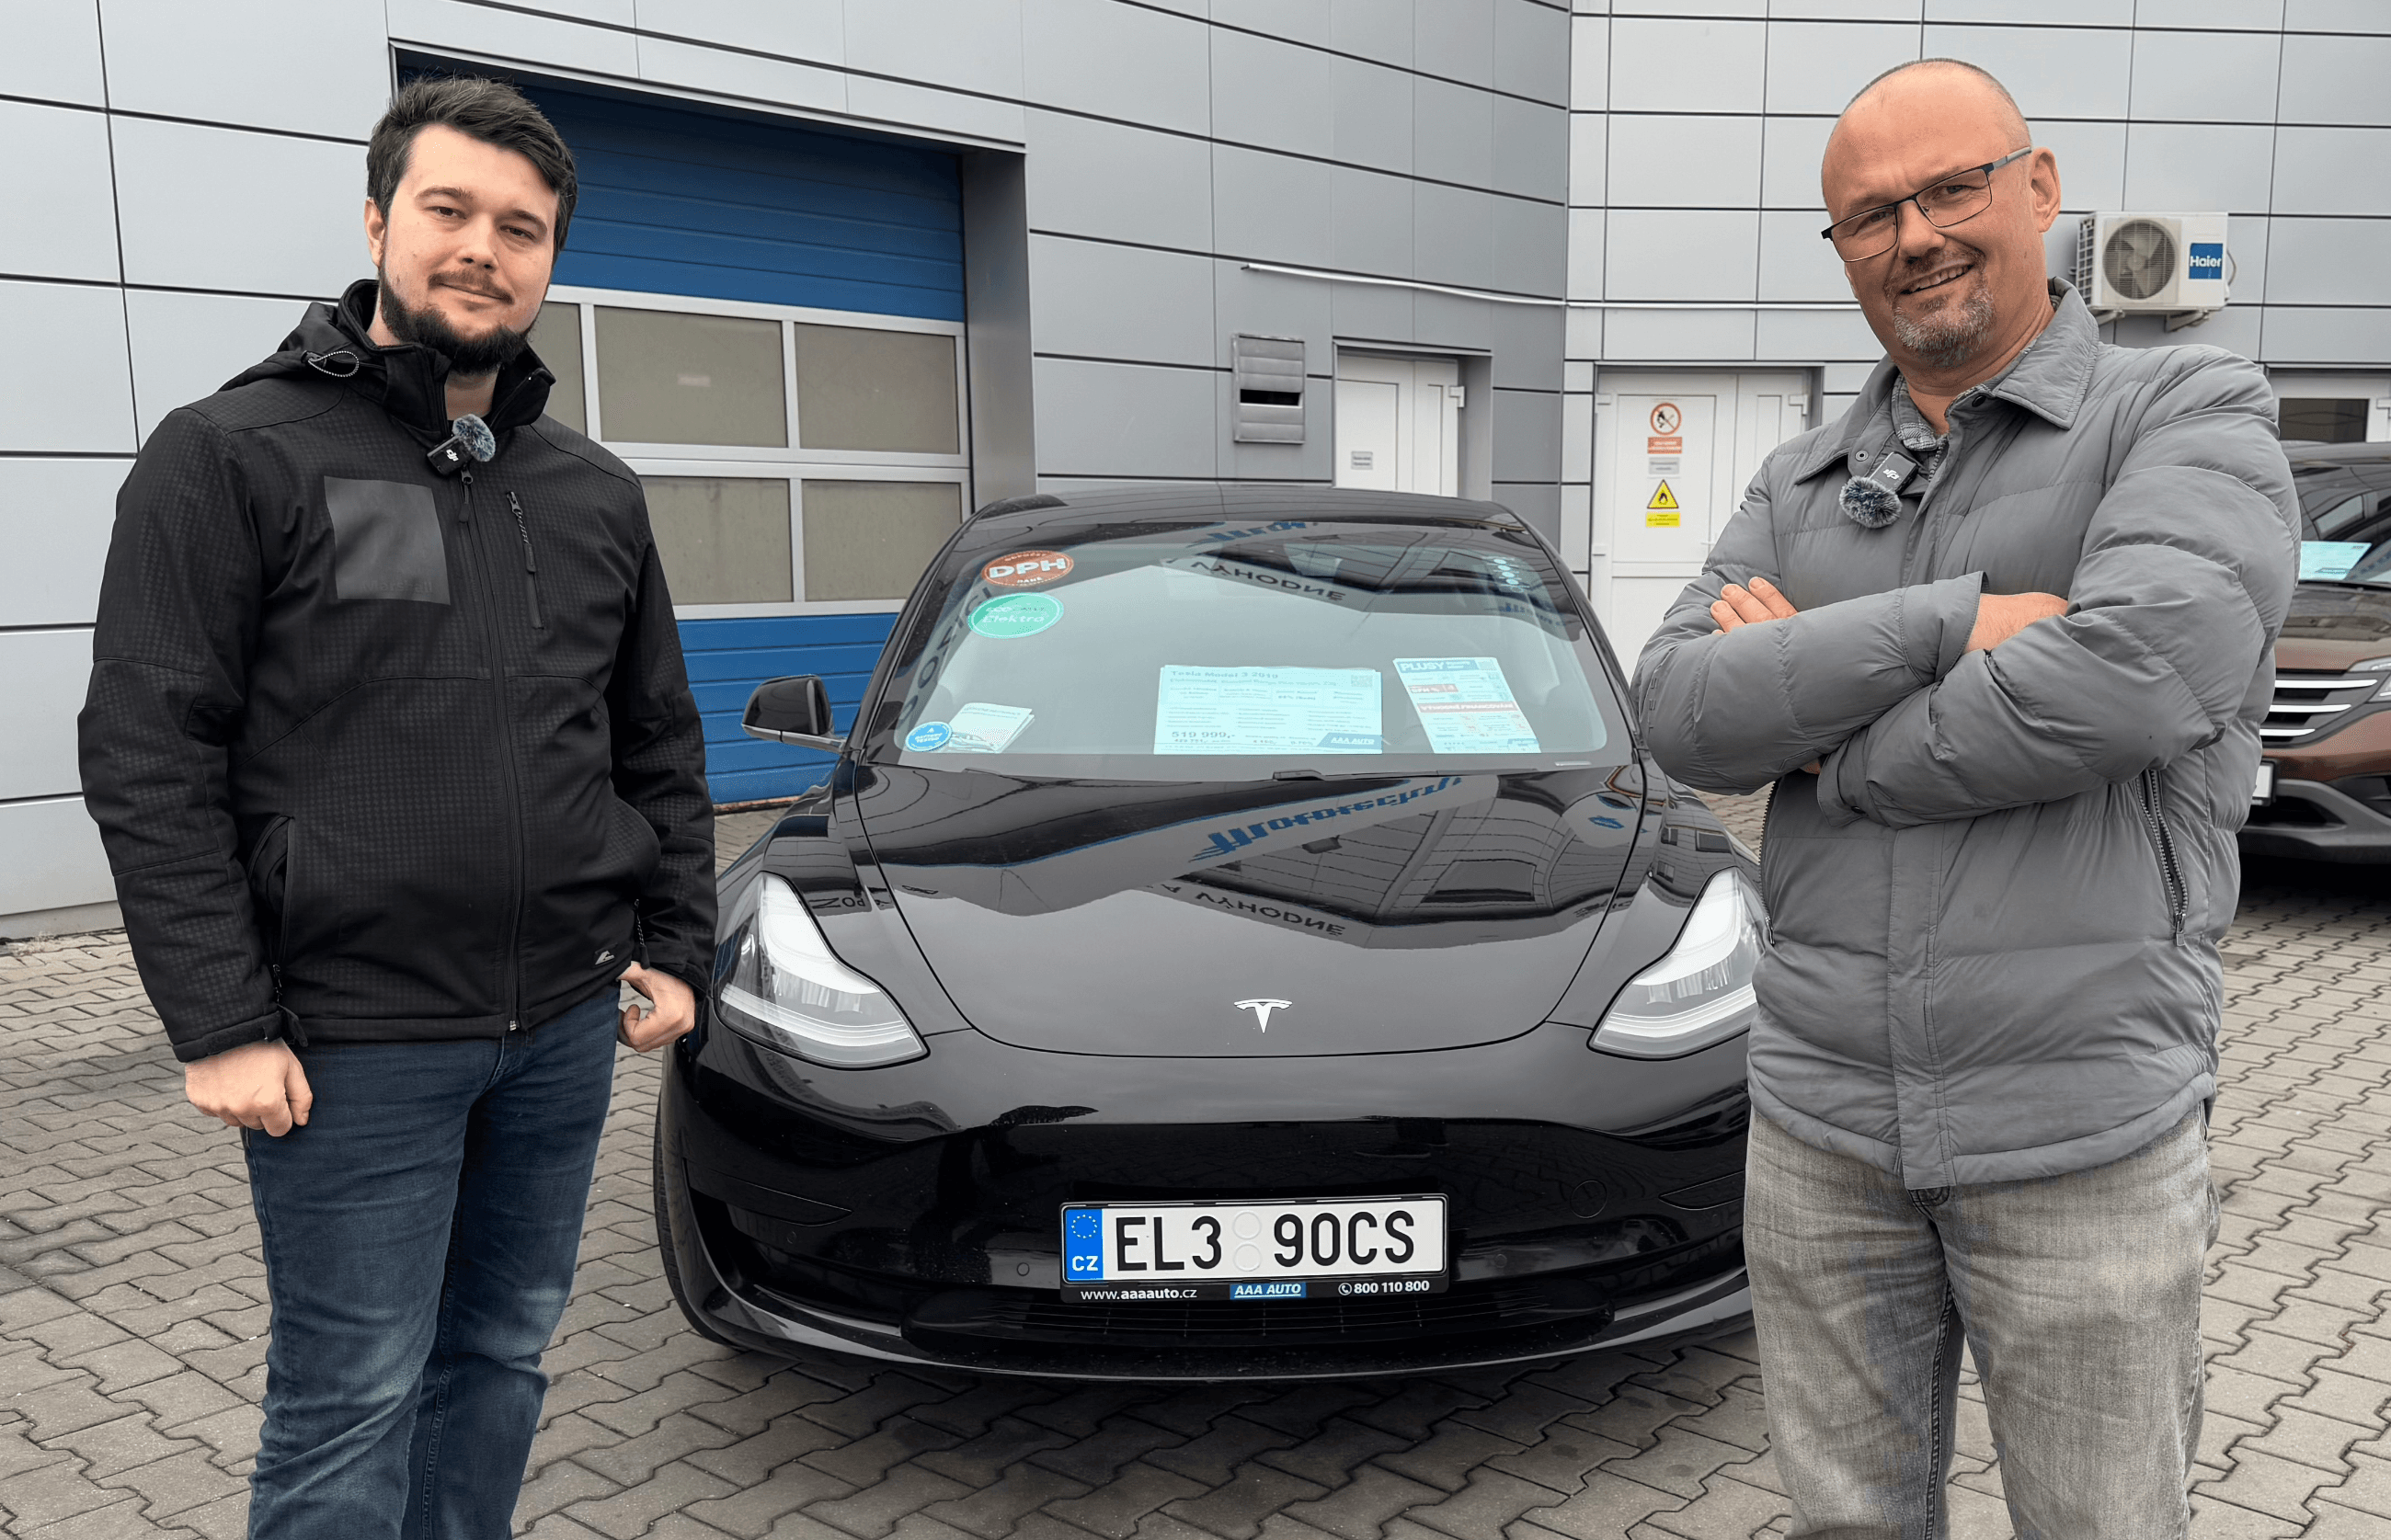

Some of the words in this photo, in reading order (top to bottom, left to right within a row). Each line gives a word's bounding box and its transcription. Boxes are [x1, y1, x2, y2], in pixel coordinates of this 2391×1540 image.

[2190, 256, 2222, 268] Haier
[989, 557, 1067, 578] DPH
[981, 614, 1046, 624] Elektro
[1400, 661, 1445, 671] PLUSY
[1115, 1215, 1222, 1272] EL3
[1274, 1210, 1414, 1268] 90CS
[1071, 1255, 1099, 1272] CZ
[1080, 1287, 1197, 1300] www.aaaauto.cz
[1234, 1284, 1264, 1295] AAA
[1266, 1283, 1302, 1295] AUTO
[1354, 1283, 1379, 1294] 800
[1381, 1282, 1403, 1293] 110
[1404, 1280, 1430, 1292] 800
